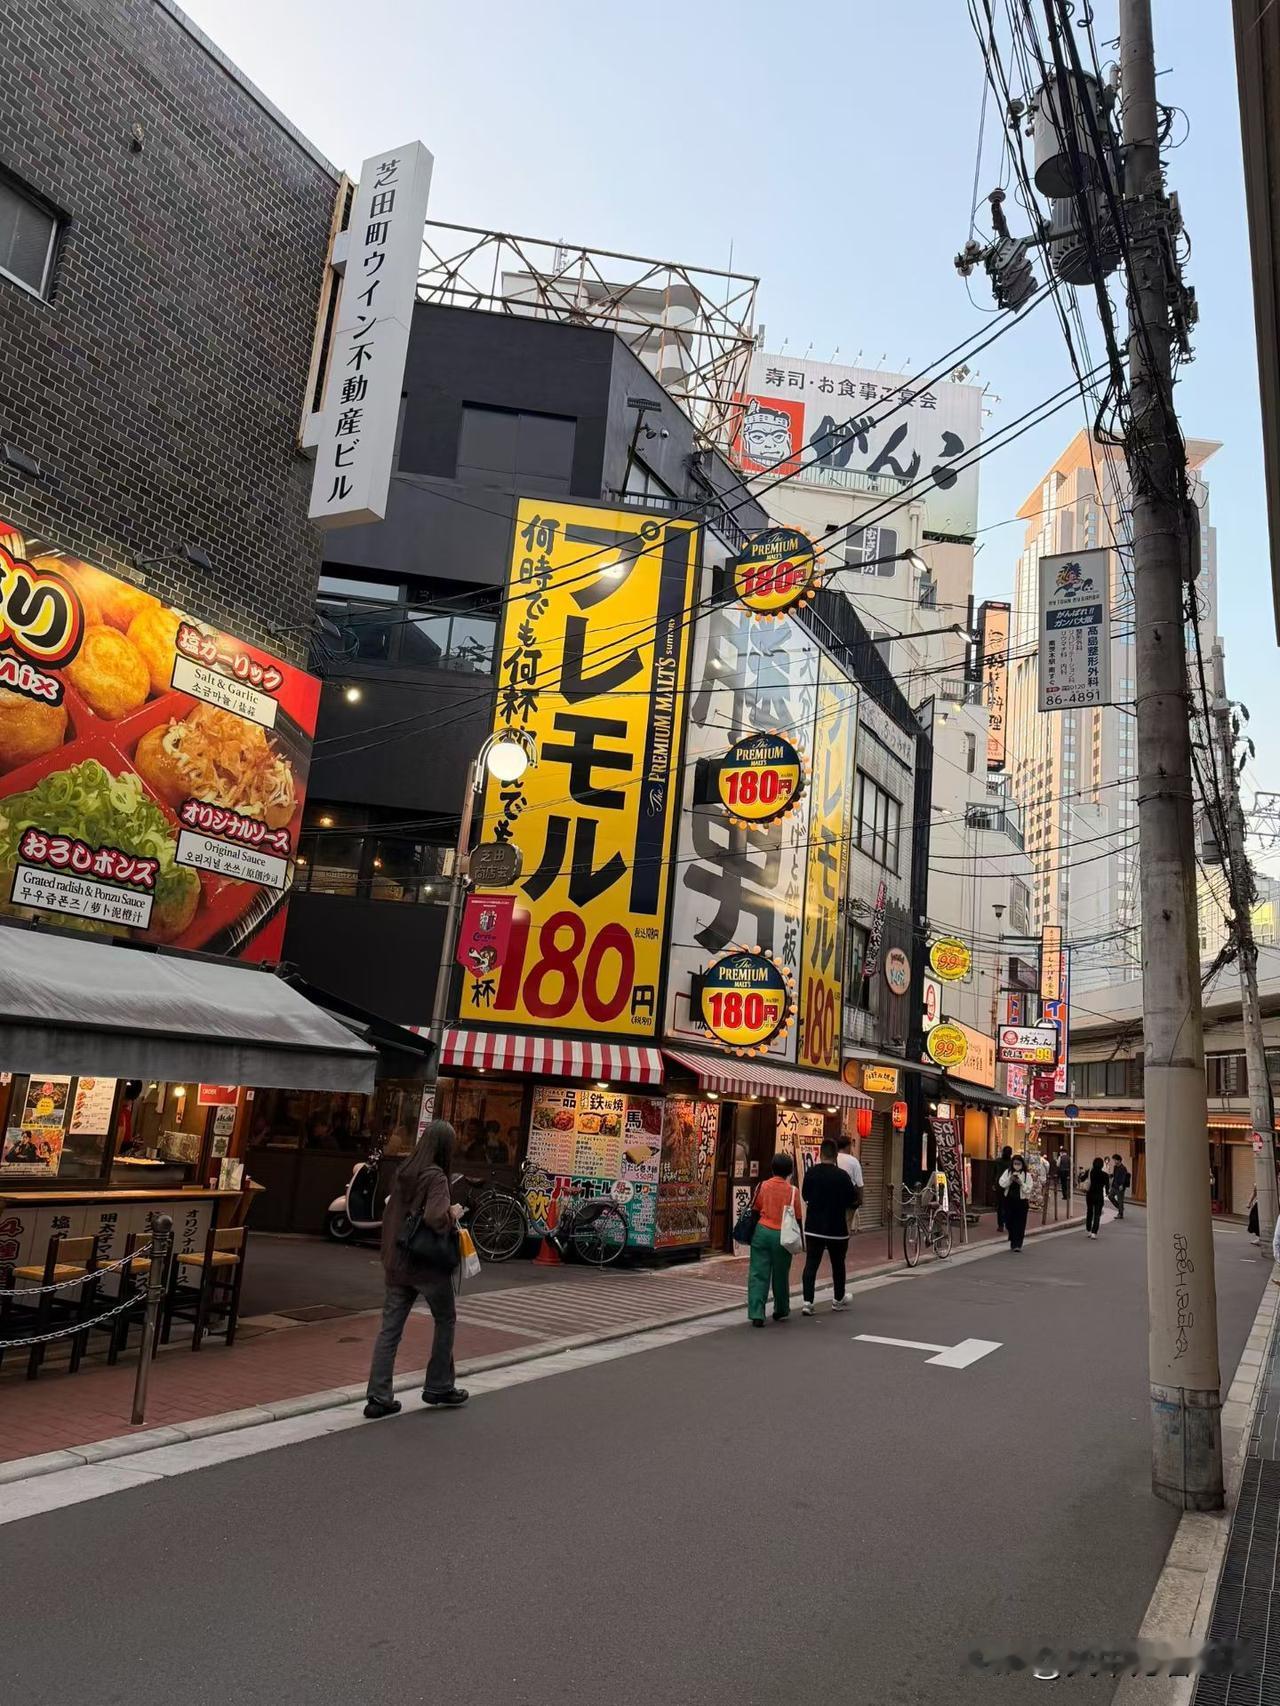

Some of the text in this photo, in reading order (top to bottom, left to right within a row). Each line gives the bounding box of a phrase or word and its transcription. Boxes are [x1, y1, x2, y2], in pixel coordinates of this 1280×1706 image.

[327, 159, 402, 503] 芝田町ウイン不動産ビル
[765, 367, 937, 410] 寿司・お食事ご宴会
[752, 538, 799, 556] PREMIUM
[180, 627, 280, 689] 塩ガーリック
[194, 668, 259, 705] Salt & Garlic
[1046, 690, 1101, 706] 86-4891
[520, 520, 660, 907] プレモル
[648, 714, 671, 783] PREMIUM
[736, 746, 784, 761] PREMIUM
[183, 802, 288, 852] オリジナルソース
[23, 832, 156, 885] おろしポンズ
[204, 841, 266, 867] Original Sauce
[23, 871, 146, 909] Grated radish & Ponzu Sauce
[719, 966, 769, 982] PREMIUM
[625, 1110, 643, 1129] 馬
[776, 1109, 799, 1131] 大分
